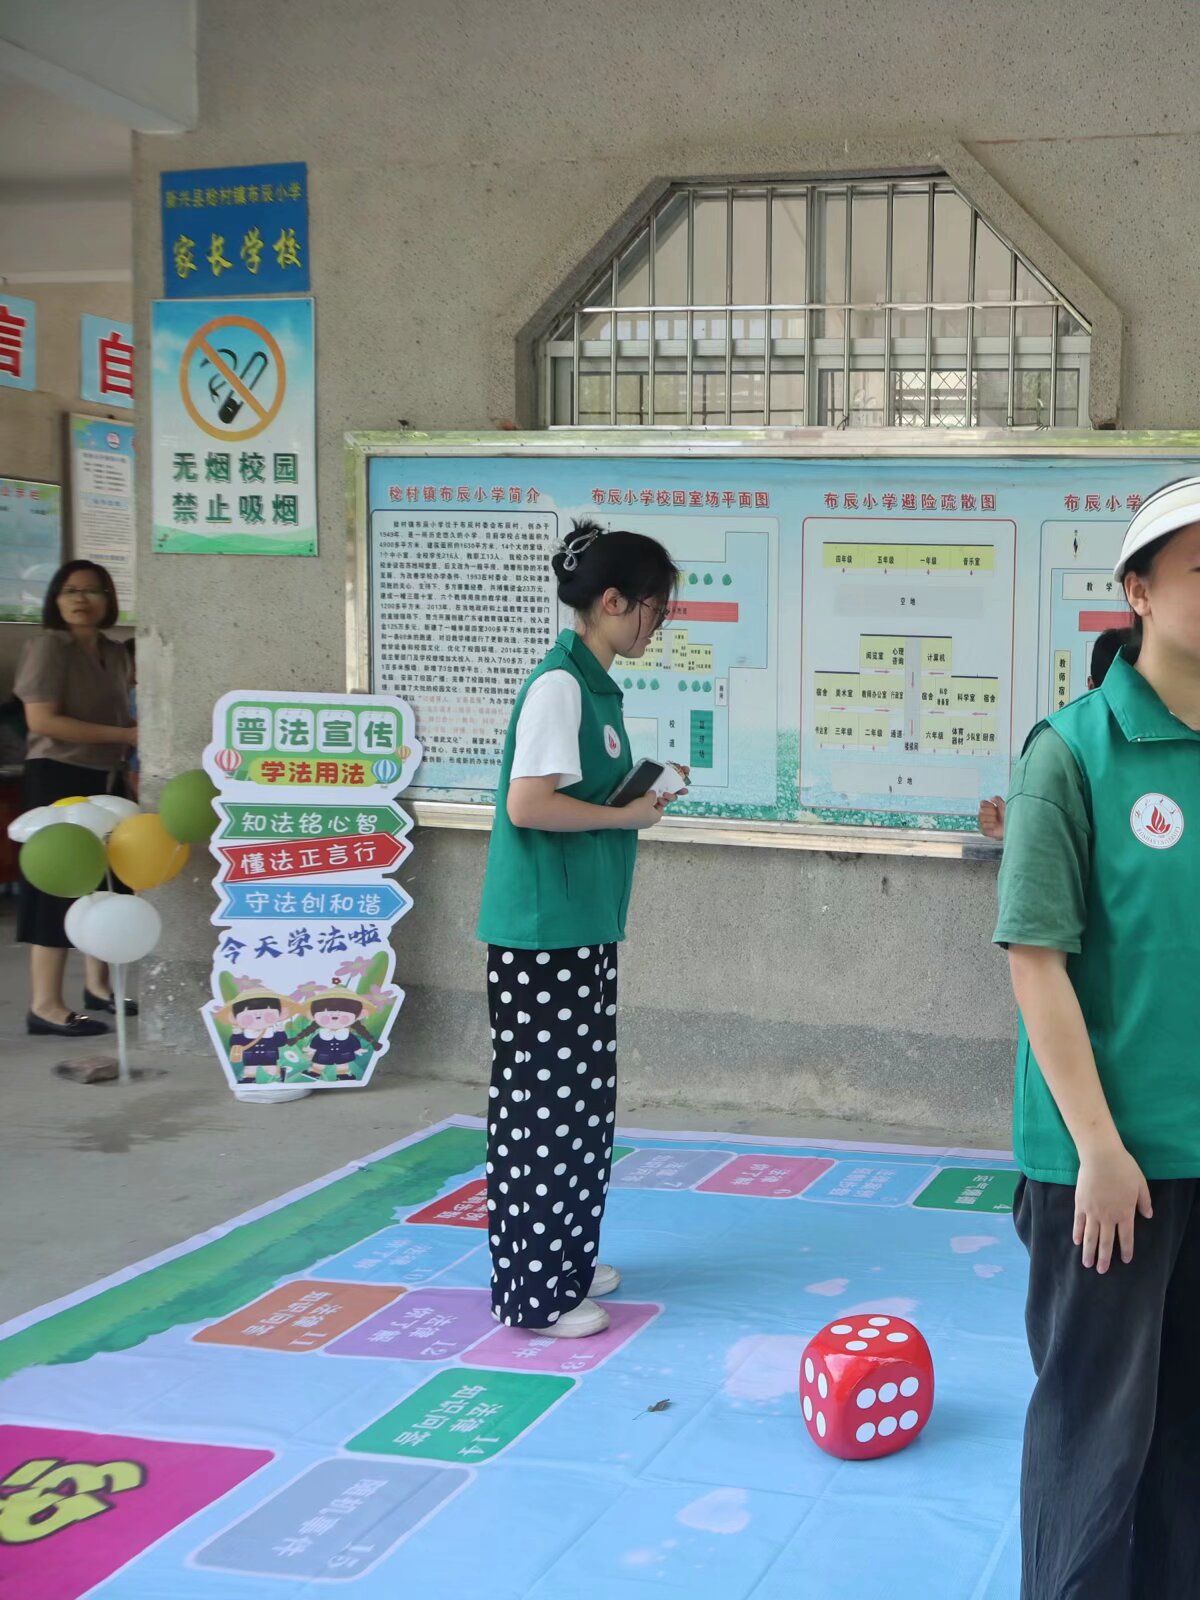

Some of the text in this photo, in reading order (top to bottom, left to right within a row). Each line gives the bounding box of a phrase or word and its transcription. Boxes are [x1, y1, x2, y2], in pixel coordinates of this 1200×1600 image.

[173, 226, 302, 279] 家长学校
[173, 452, 299, 484] 无烟校园
[172, 493, 299, 527] 禁止吸烟
[591, 487, 771, 508] 布辰小学校园室场平面图
[823, 492, 997, 511] 布辰小学避险疏散图
[235, 716, 396, 750] 普法宣传
[260, 760, 366, 786] 学法用法
[241, 810, 379, 835] 知法铭心智
[240, 840, 377, 875] 懂法正言行
[245, 891, 382, 916] 守法创和谐
[220, 923, 382, 965] 今天学法啦
[241, 1289, 333, 1337] 知识问答
[294, 1304, 344, 1328] 法律
[367, 1306, 435, 1343] 你了解
[288, 1330, 329, 1347] 11
[407, 1314, 459, 1339] 法律
[420, 1339, 458, 1356] 12
[560, 1352, 596, 1371] 13
[391, 1384, 488, 1448] 知识问答
[449, 1402, 505, 1434] 法律
[457, 1434, 500, 1458] 14
[271, 1478, 391, 1557] 随机事件
[327, 1543, 375, 1569] 15
